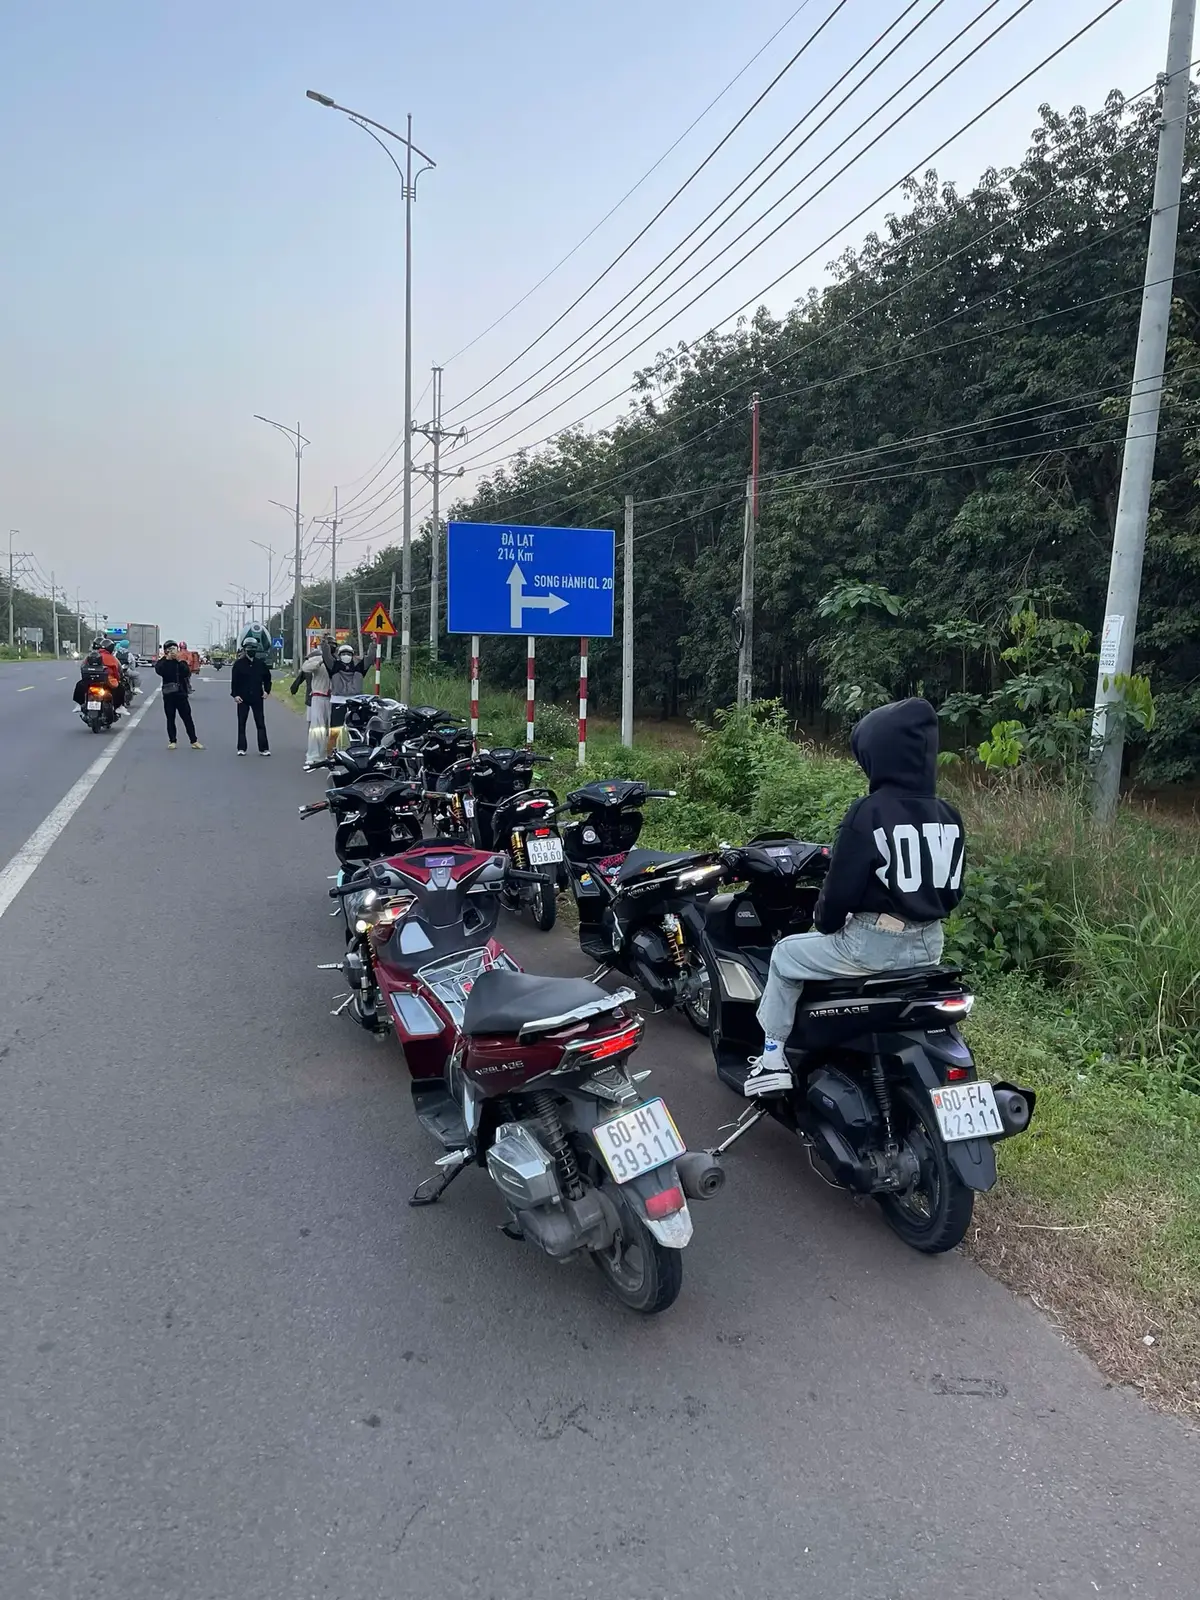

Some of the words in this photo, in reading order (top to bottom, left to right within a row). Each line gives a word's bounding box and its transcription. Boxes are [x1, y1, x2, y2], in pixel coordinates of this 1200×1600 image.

[501, 530, 514, 546] ĐÀ
[517, 533, 534, 548] LẠT
[498, 548, 515, 560] 214
[517, 549, 533, 562] Km
[534, 575, 559, 588] SONG
[562, 573, 587, 588] HÀNH
[588, 577, 599, 590] QL
[602, 577, 613, 590] 20
[531, 850, 561, 864] 058.60
[808, 1005, 870, 1018] AIRBLADE
[594, 1065, 616, 1077] HONDA
[941, 1085, 987, 1112] 60-F4
[606, 1106, 660, 1148] 60-H1
[943, 1108, 1000, 1138] 423.11
[611, 1128, 679, 1178] 393.11
